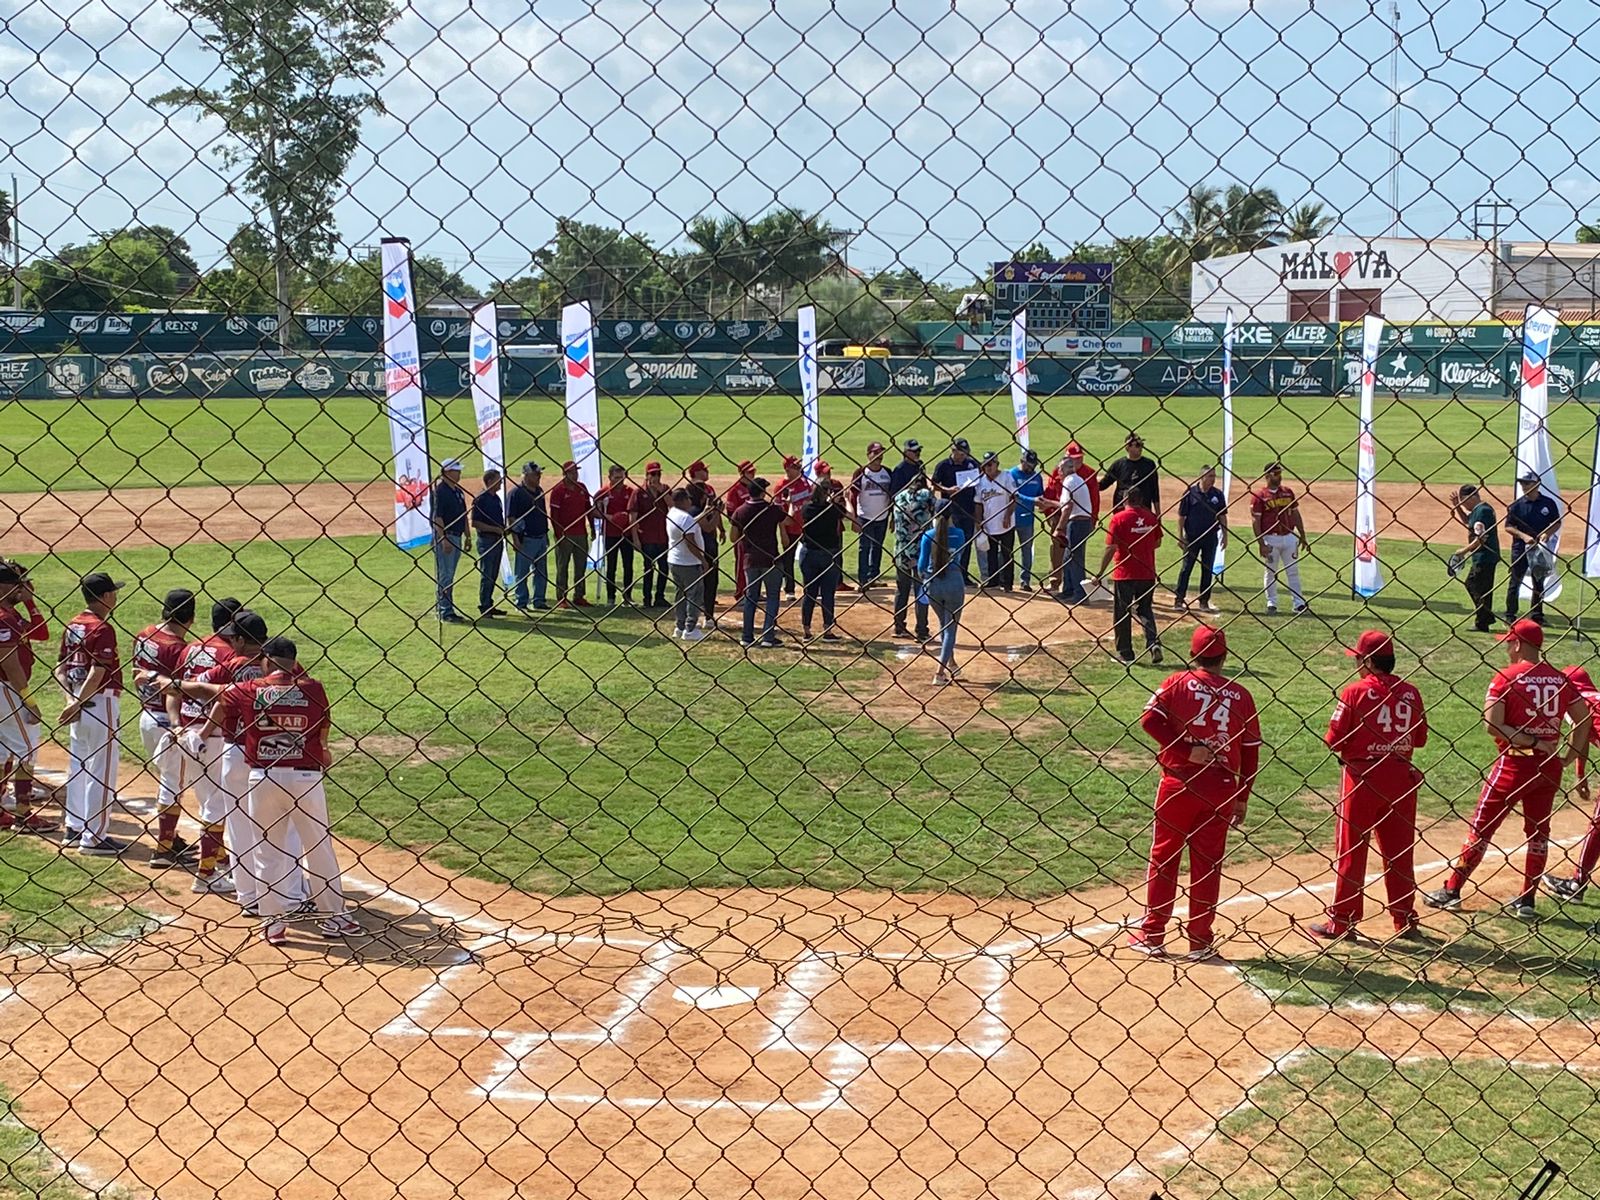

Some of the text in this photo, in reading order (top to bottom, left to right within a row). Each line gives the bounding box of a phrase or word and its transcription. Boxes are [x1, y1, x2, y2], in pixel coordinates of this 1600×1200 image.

[999, 339, 1040, 349] Chon
[1081, 338, 1122, 349] Cheron
[1440, 361, 1501, 389] Kleenex
[1192, 691, 1231, 732] 74
[1525, 684, 1560, 717] 30
[1376, 700, 1412, 733] 49
